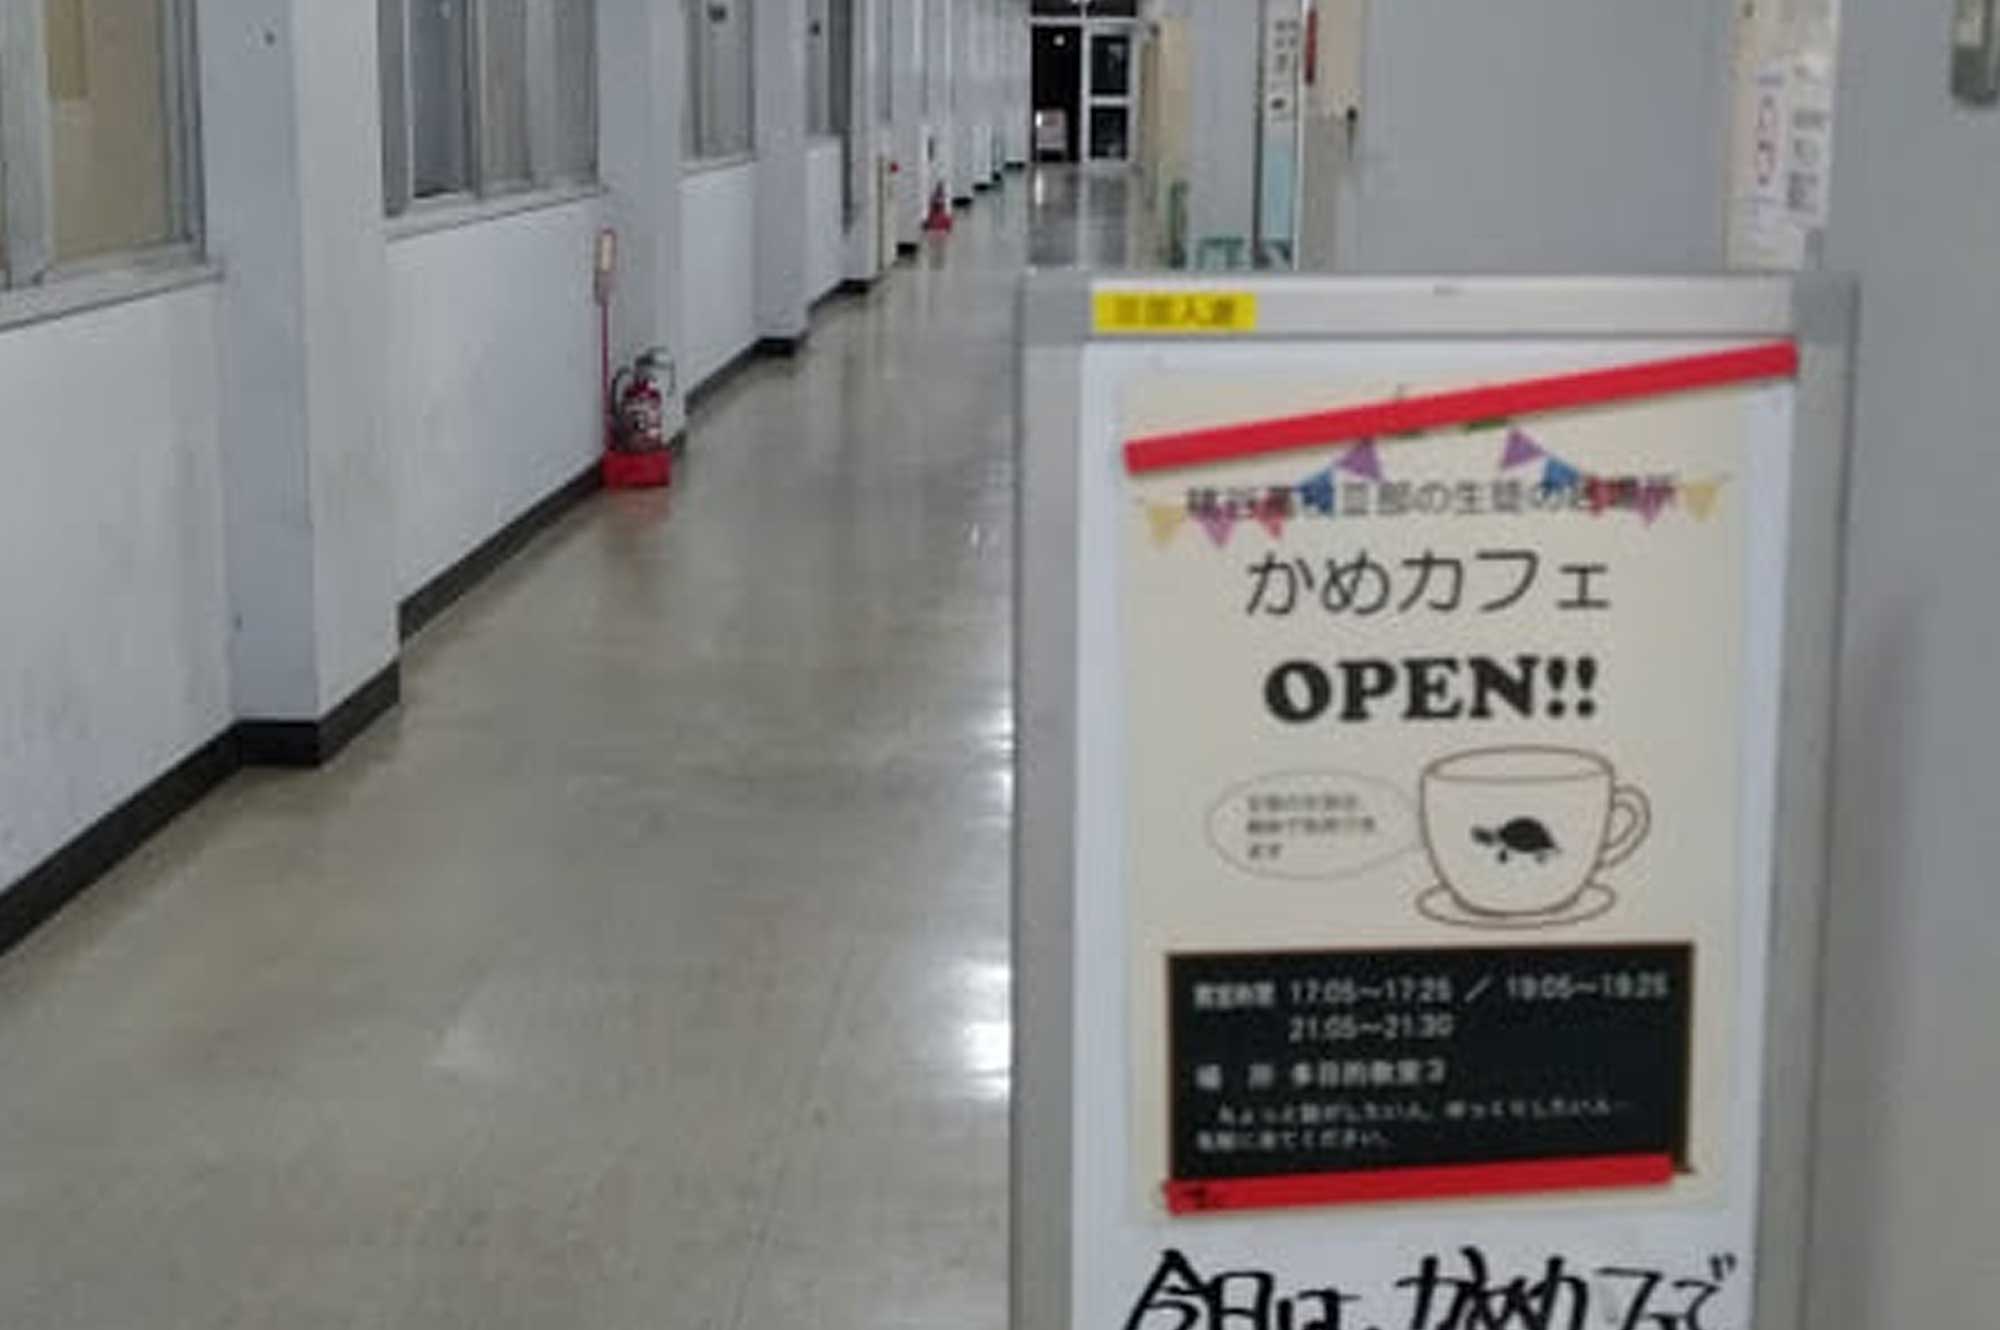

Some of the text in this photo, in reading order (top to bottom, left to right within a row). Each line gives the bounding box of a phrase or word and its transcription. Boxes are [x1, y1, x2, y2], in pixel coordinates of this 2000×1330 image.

[1245, 549, 1612, 617] かめカフェ
[1264, 655, 1598, 722] OPEN!!
